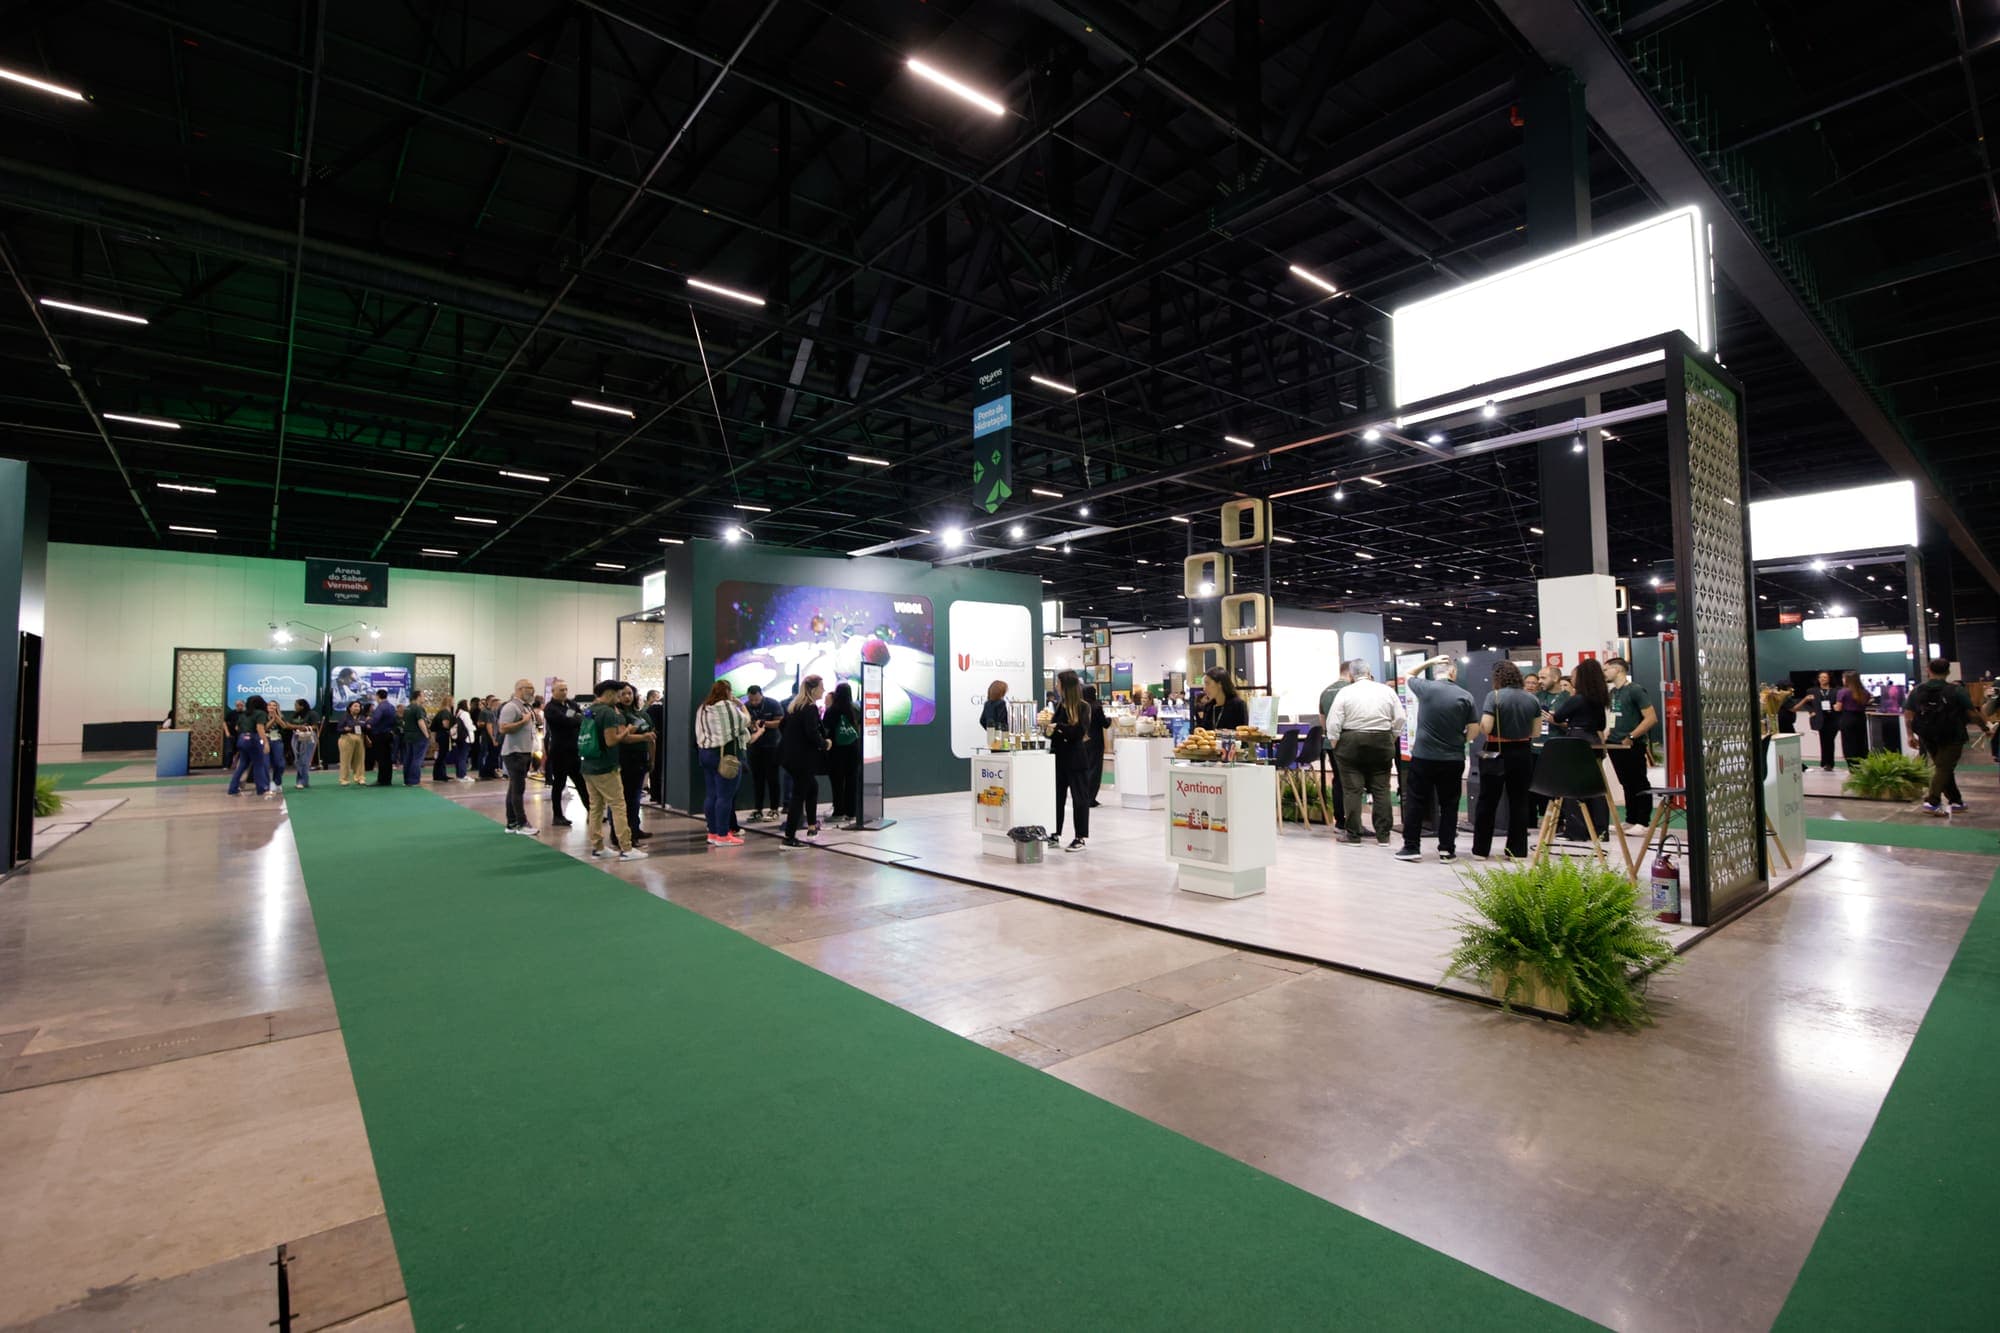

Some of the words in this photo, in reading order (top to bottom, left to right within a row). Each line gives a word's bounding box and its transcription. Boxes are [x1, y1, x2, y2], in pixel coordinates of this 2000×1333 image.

[978, 408, 995, 421] Ponto
[995, 404, 1004, 414] de
[974, 413, 1008, 432] Hidratação
[334, 566, 361, 575] Arena
[328, 573, 341, 581] do
[341, 574, 367, 583] Saber
[327, 580, 369, 591] Vermelha
[237, 683, 292, 694] focaldata
[981, 768, 1004, 779] Bio-C
[1177, 780, 1223, 798] Xantinon
